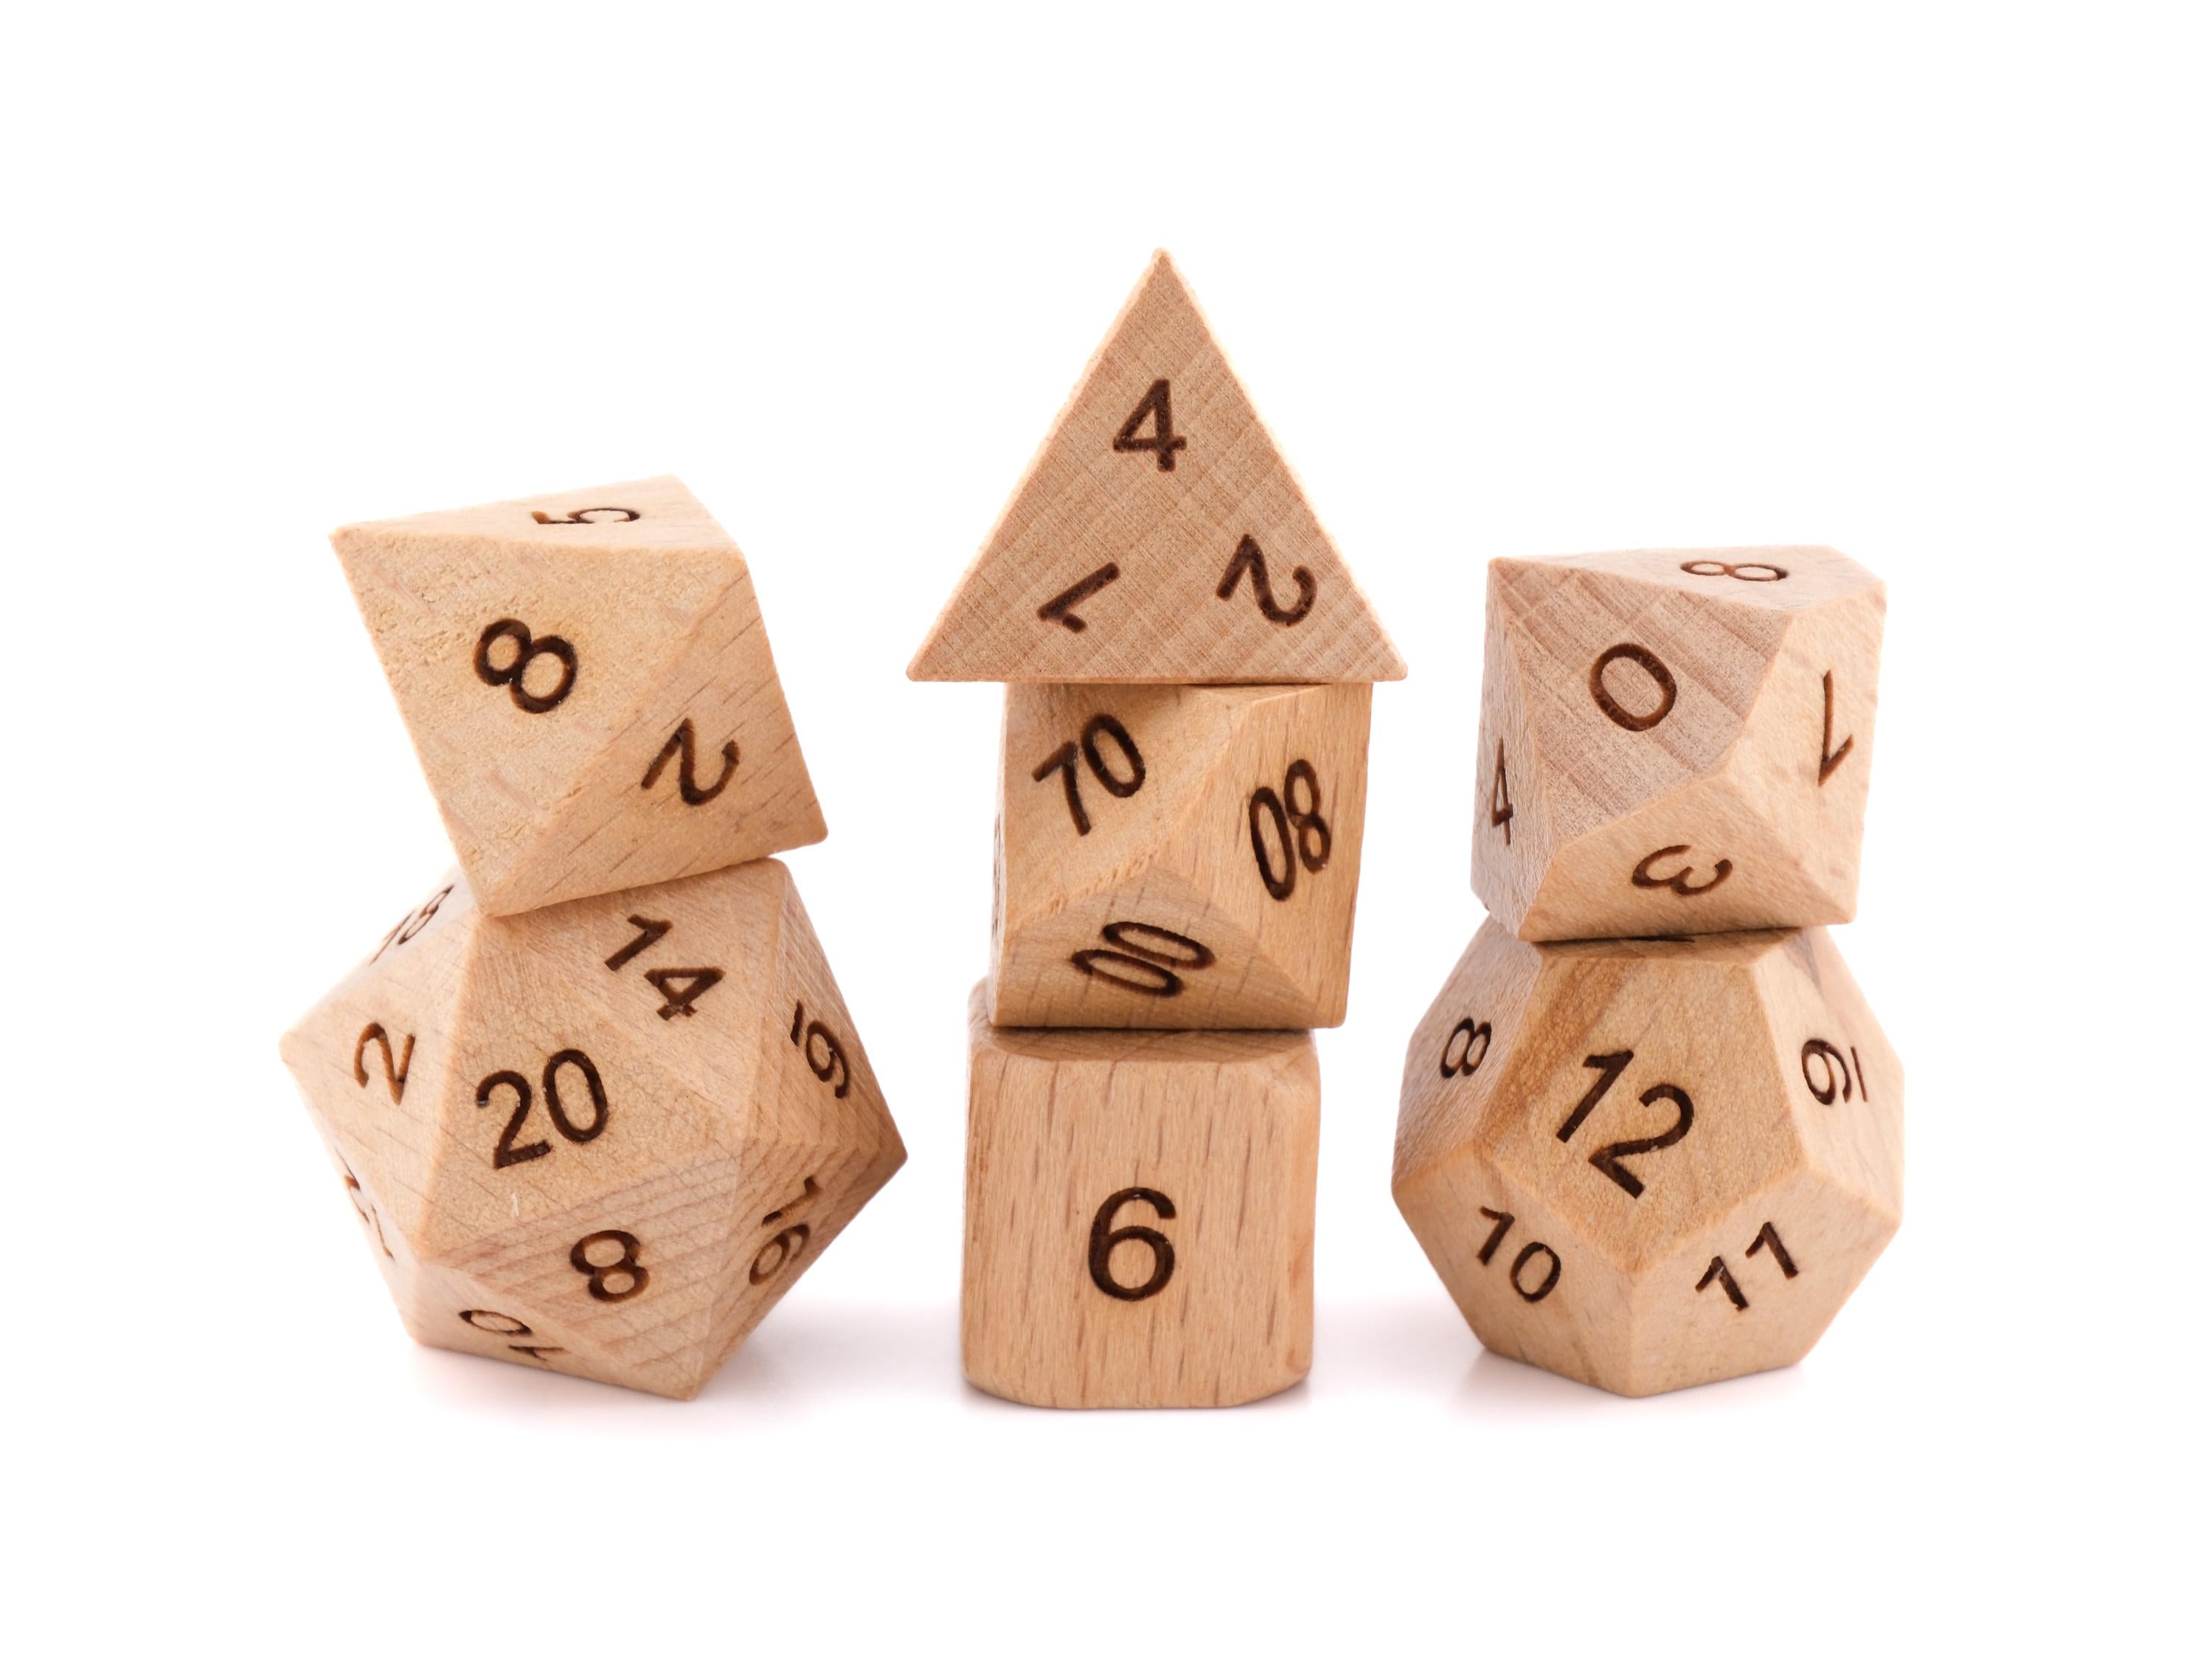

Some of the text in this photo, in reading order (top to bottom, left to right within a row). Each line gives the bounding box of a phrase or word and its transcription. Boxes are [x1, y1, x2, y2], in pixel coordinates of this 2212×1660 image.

[1112, 378, 1187, 473] 4
[531, 507, 641, 525] 5
[1037, 562, 1120, 634] 1
[1216, 533, 1317, 627] 2
[1679, 561, 1788, 581] 8
[474, 618, 578, 714] 8
[1590, 643, 1677, 732] 0
[641, 717, 740, 809] 2
[1031, 713, 1146, 837] 70
[1817, 670, 1854, 786] 1
[1248, 758, 1332, 902] 80
[1490, 736, 1514, 845] 4
[1632, 844, 1733, 896] 3
[603, 913, 726, 1021] 14
[1067, 920, 1216, 1006] 00
[353, 1022, 416, 1106] 2
[1439, 1017, 1493, 1080] 8
[476, 1048, 610, 1171] 20
[1556, 1048, 1695, 1200] 12
[569, 1228, 648, 1304] 8
[749, 1175, 822, 1286] 16
[1087, 1186, 1177, 1303] 6
[1477, 1206, 1562, 1304] 10
[1695, 1221, 1800, 1313] 11
[458, 1309, 571, 1362] 10
